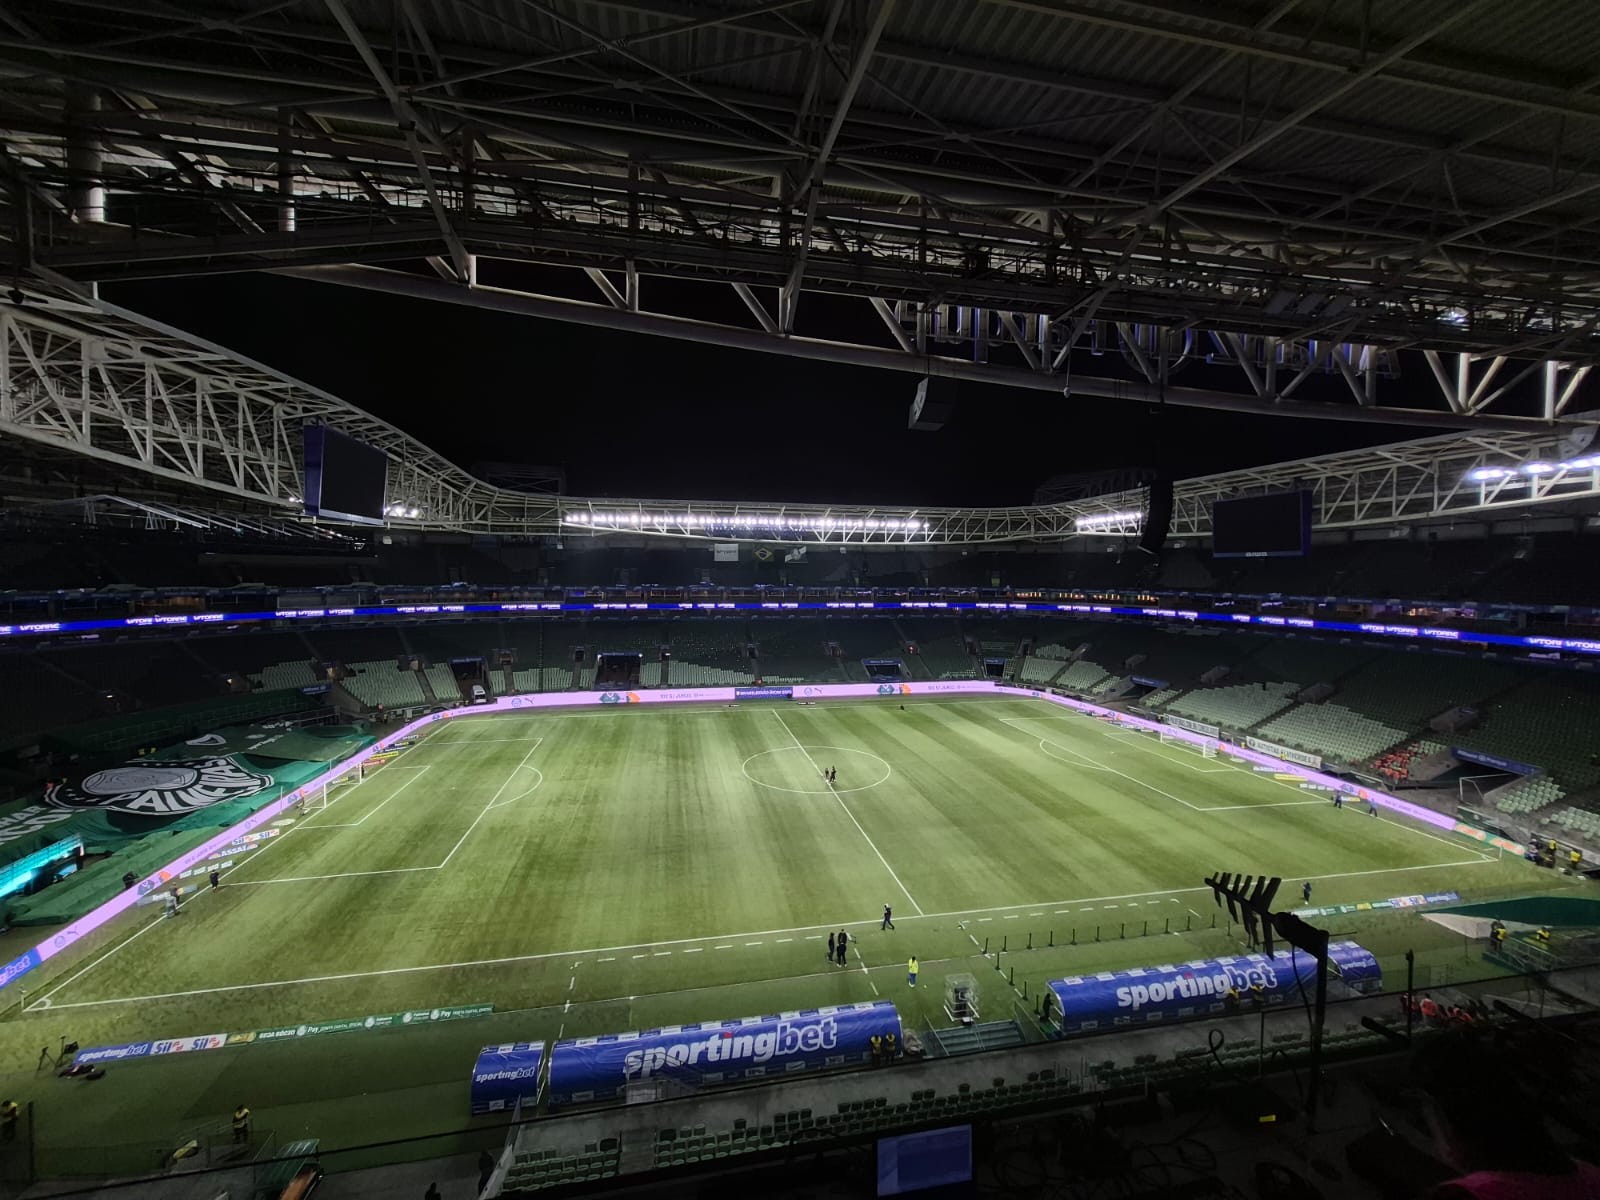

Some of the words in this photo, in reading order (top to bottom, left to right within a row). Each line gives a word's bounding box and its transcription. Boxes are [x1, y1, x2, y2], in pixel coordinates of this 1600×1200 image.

[1117, 961, 1277, 1010] sportingbet
[155, 1041, 171, 1054] Sil
[191, 1036, 208, 1051] Sil
[623, 1019, 838, 1080] sportingbet
[475, 1066, 535, 1083] sportingbet
